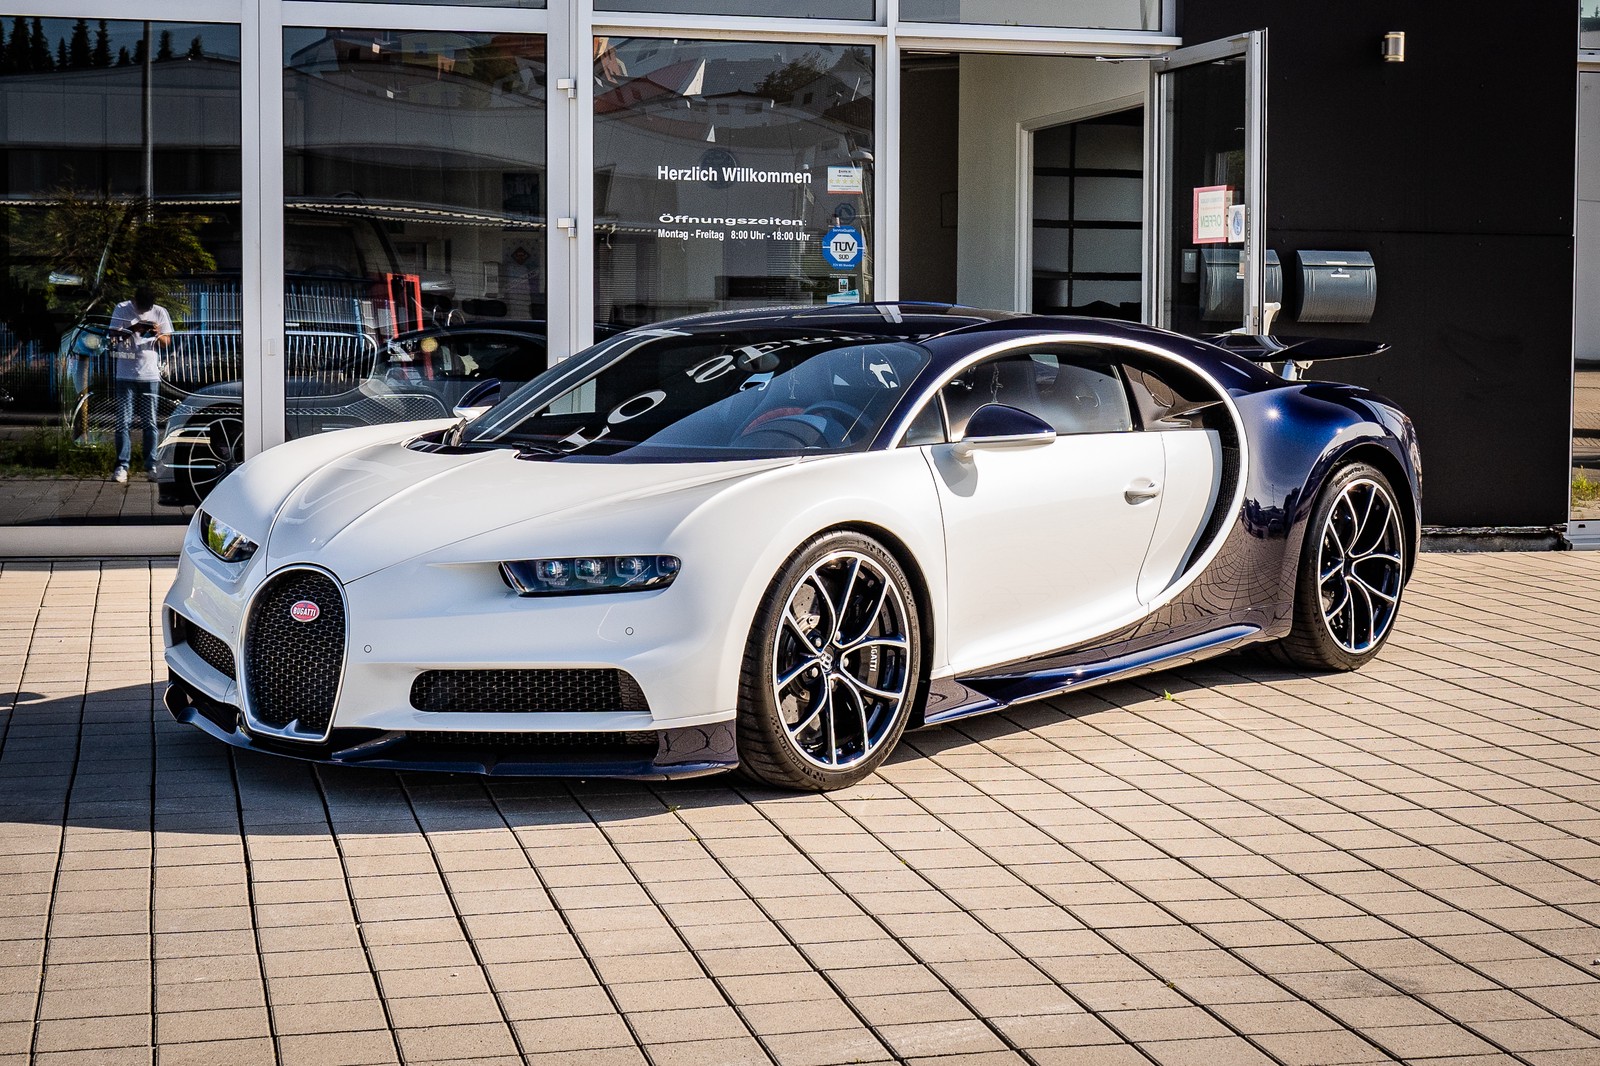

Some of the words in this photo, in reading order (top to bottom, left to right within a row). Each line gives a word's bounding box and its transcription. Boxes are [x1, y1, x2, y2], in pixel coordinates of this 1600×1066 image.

[657, 165, 718, 182] Herzlich
[722, 166, 812, 184] Willkommen
[658, 213, 807, 226] Öffnungszeiten:
[657, 229, 689, 240] Montag
[695, 229, 725, 241] Freitag
[731, 230, 748, 239] 8:00
[750, 230, 766, 240] Uhr
[772, 231, 794, 241] 18:00
[796, 231, 811, 241] Uhr
[833, 241, 855, 252] TÜV
[883, 555, 908, 590] MICHELIN
[293, 607, 317, 616] BUGATTI
